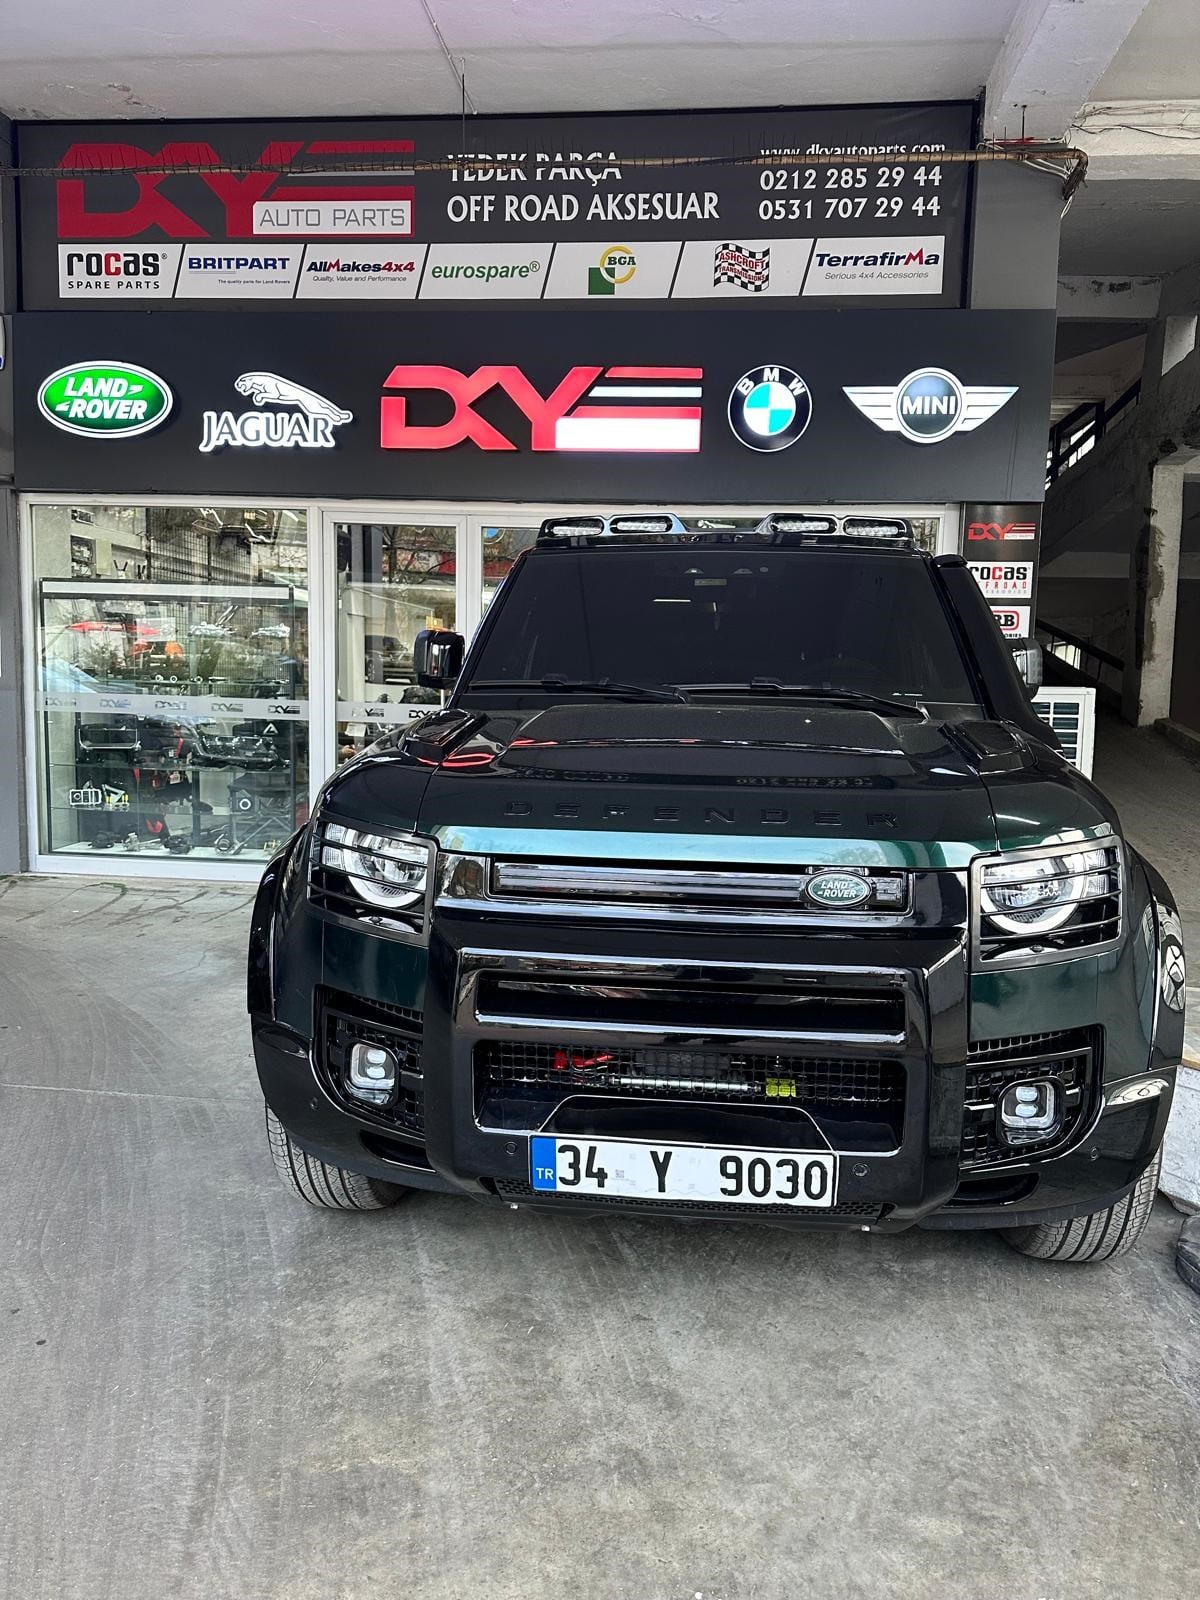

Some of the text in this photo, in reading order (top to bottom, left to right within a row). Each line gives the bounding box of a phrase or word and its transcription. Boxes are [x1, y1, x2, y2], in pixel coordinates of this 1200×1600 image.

[447, 152, 622, 187] YEDEK PARÇA
[760, 165, 942, 190] 0212 285 29 44
[447, 191, 720, 222] OFF ROAD AKSESUAR
[758, 196, 941, 221] 0531 707 29 44
[260, 207, 405, 227] AUTO PARTS
[188, 257, 290, 270] BRITPART
[607, 256, 637, 266] BGA
[720, 250, 766, 270] ASHCROFT
[719, 266, 766, 282] TRANSMISSIONS
[824, 272, 857, 280] Serious
[876, 271, 929, 280] Accessories
[67, 280, 160, 290] SPARE PARTS
[63, 377, 123, 398] LAND
[737, 367, 806, 397] BMW
[68, 399, 148, 420] ROVER
[902, 395, 957, 415] MINI
[200, 411, 337, 451] JAGUAR
[504, 801, 899, 828] DEFENDER
[820, 880, 849, 889] LAND
[823, 889, 857, 898] ROVER
[535, 1167, 554, 1180] TR
[557, 1144, 828, 1200] 34 Y 9030
